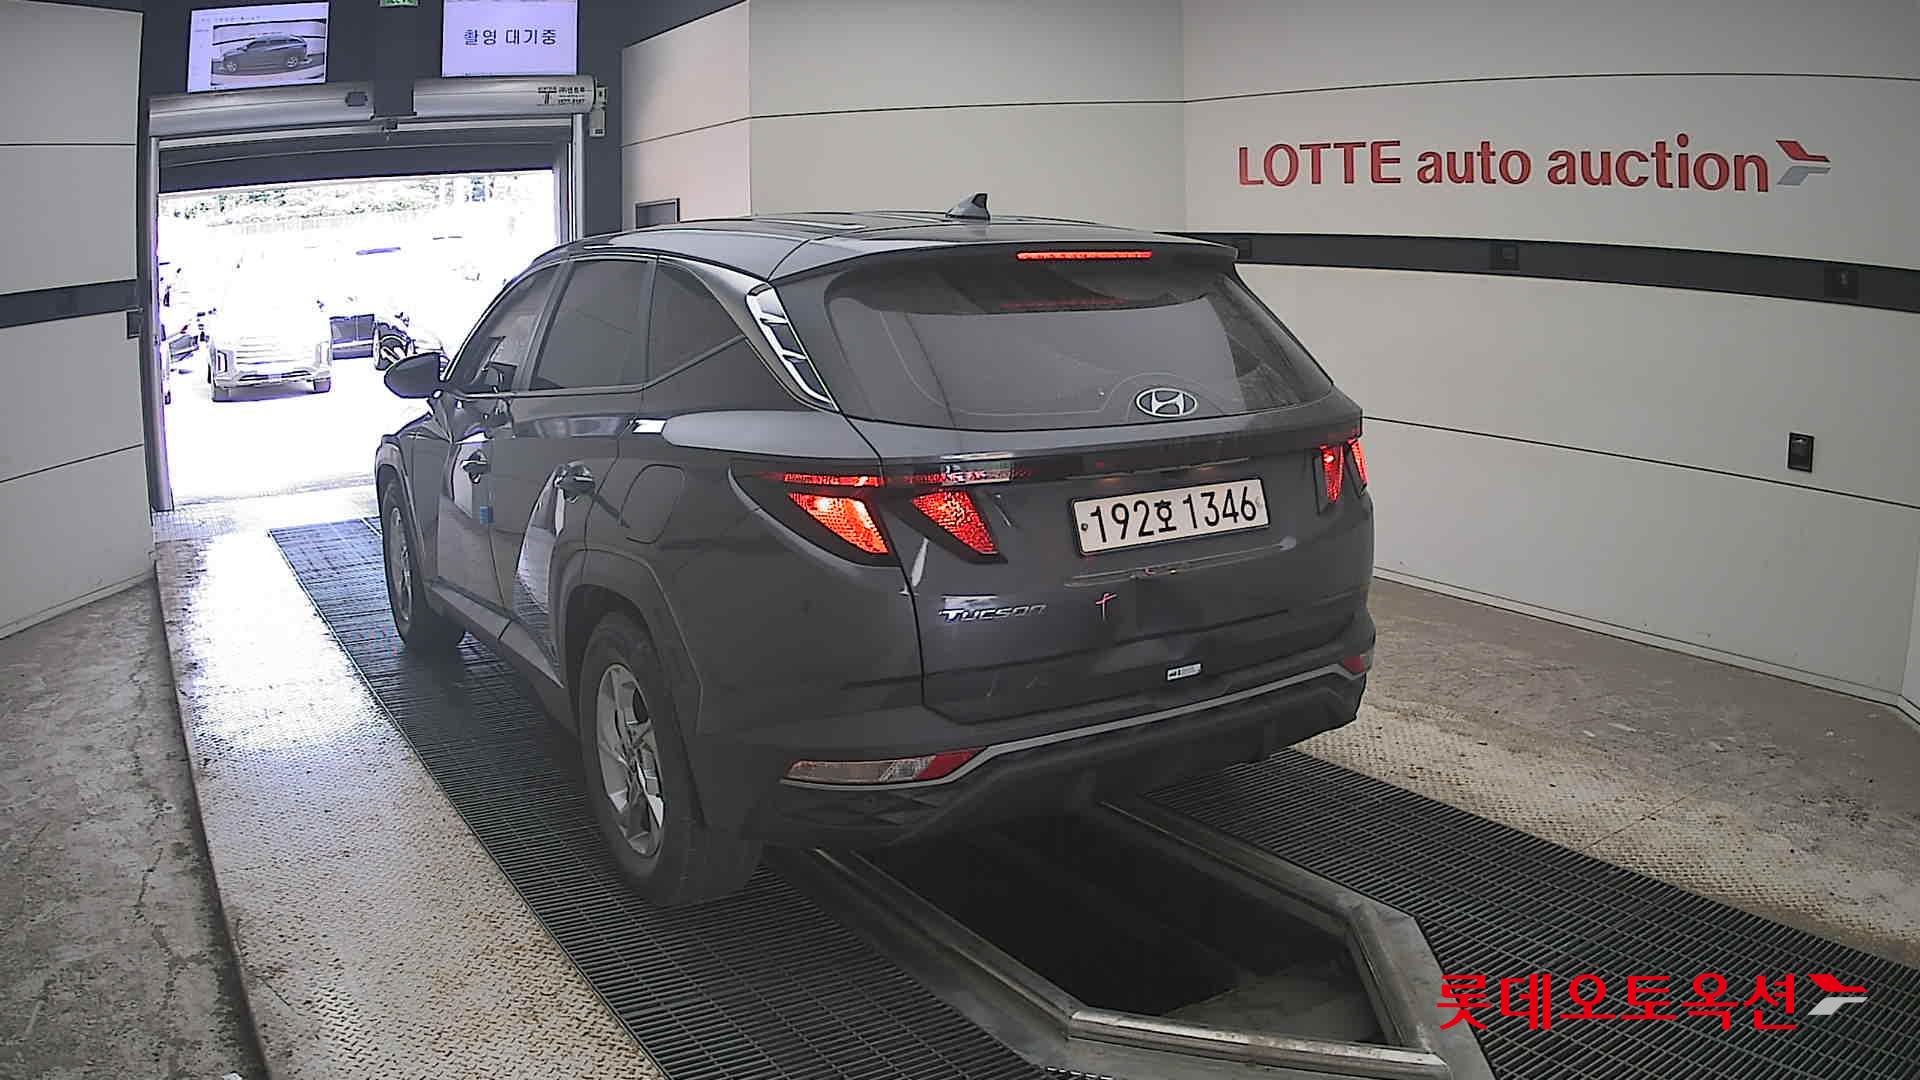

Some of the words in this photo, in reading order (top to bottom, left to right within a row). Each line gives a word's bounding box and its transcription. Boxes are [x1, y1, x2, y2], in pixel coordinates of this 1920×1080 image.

[505, 29, 556, 46] 대기중
[1238, 140, 1400, 187] LOTTE
[1416, 140, 1532, 186] auto
[1546, 133, 1769, 193] auction
[1090, 500, 1176, 543] 192호
[1183, 486, 1257, 529] 1346
